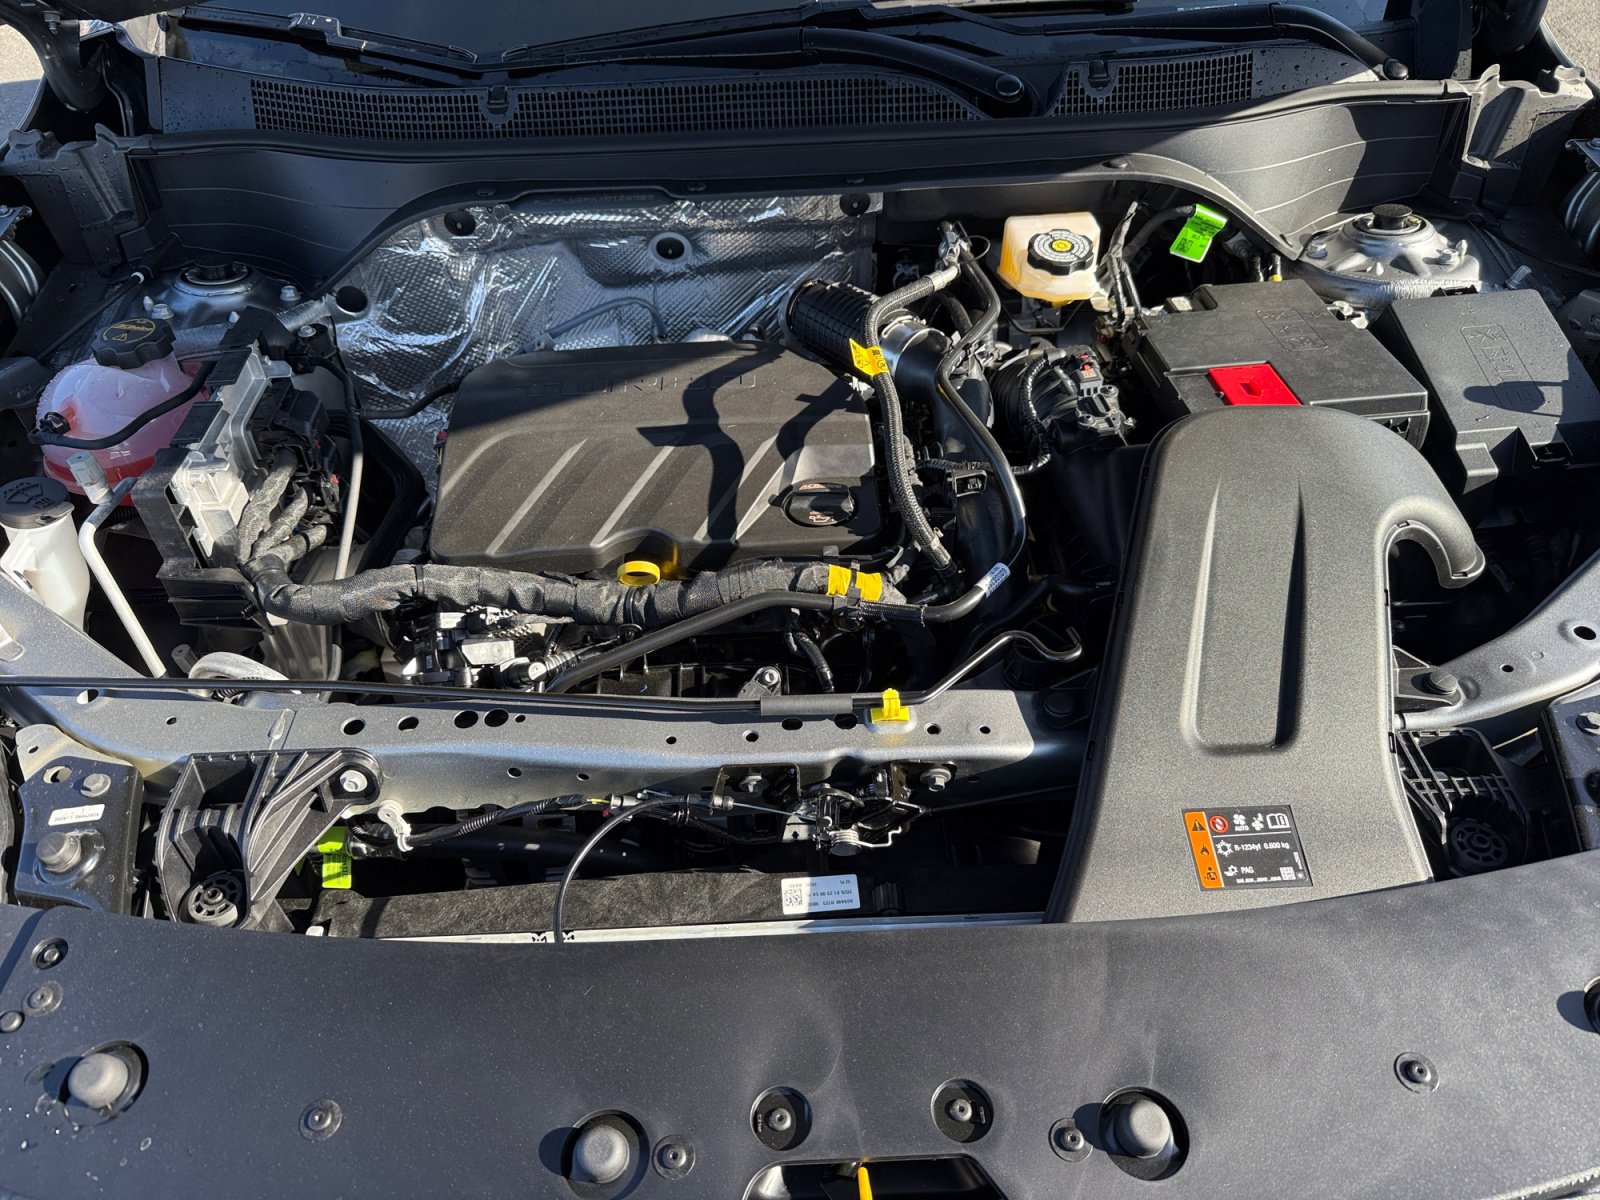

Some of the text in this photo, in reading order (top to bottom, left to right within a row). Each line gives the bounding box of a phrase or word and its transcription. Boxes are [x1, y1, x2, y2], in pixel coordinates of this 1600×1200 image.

[1234, 843, 1262, 852] R-1234yf
[1281, 841, 1290, 850] kg
[1240, 866, 1254, 874] PAG
